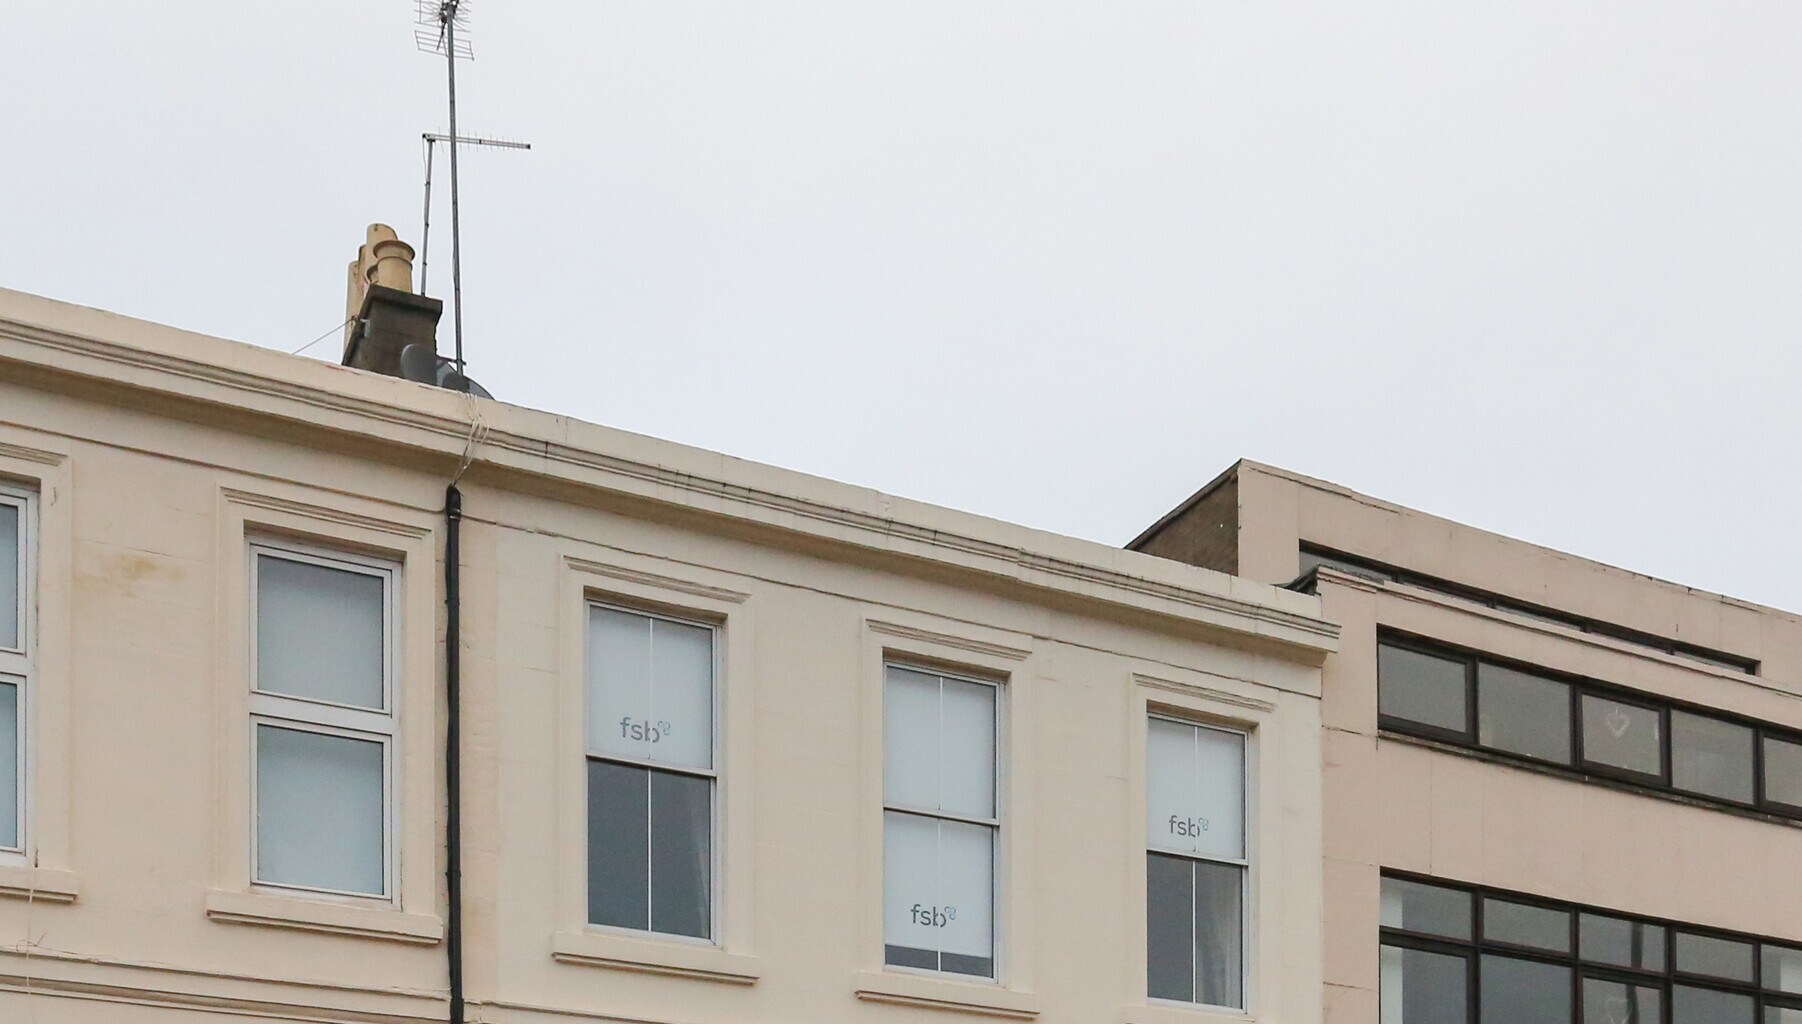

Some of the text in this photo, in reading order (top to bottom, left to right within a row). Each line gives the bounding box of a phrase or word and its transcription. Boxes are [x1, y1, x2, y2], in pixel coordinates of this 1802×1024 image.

[620, 716, 660, 743] fsb
[1169, 815, 1201, 838] fsb
[910, 903, 947, 928] fsb
